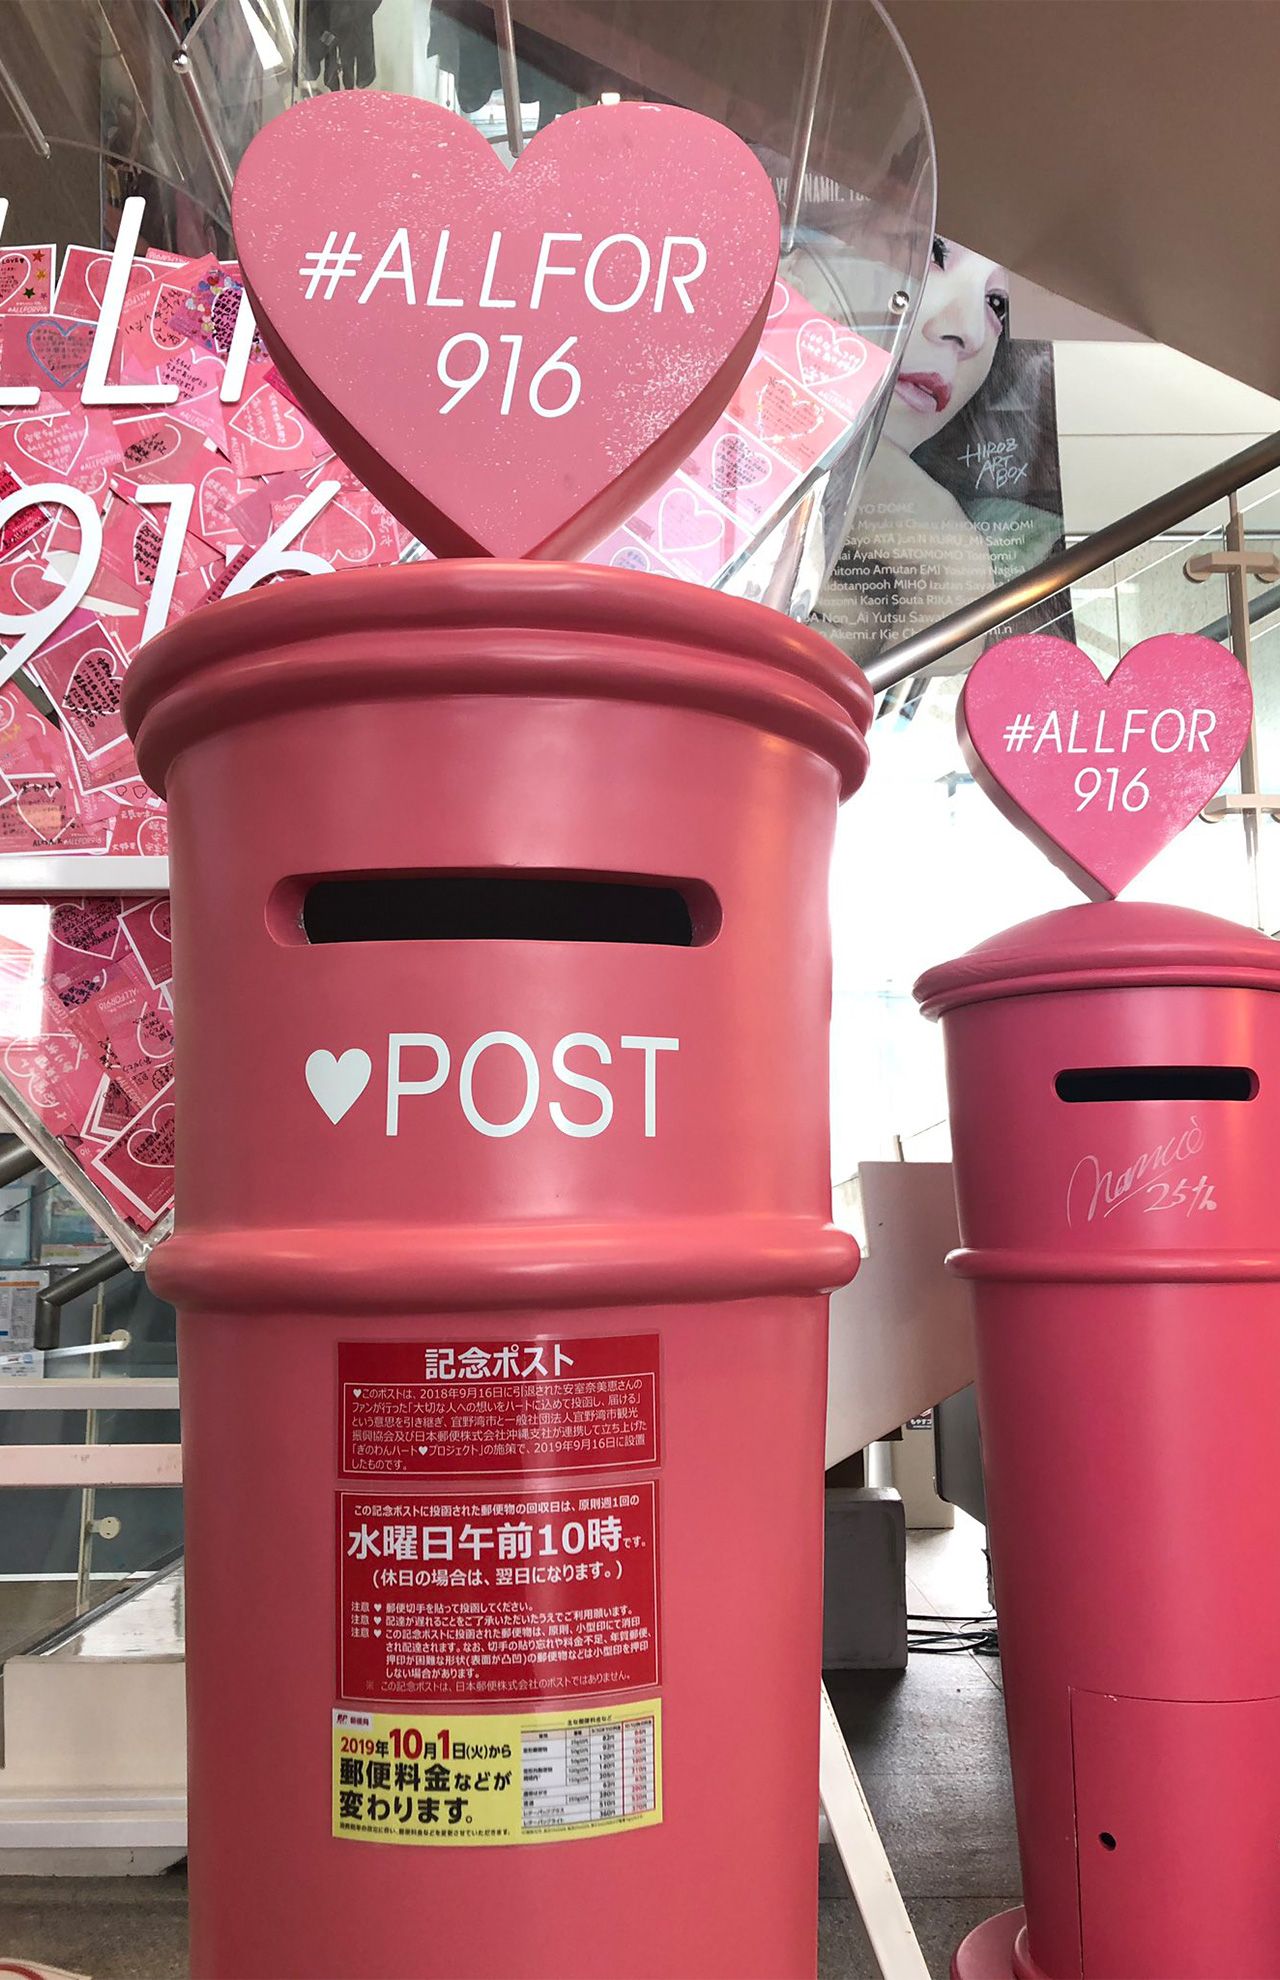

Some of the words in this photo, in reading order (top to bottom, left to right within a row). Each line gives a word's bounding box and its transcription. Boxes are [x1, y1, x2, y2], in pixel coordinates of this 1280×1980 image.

[300, 229, 706, 314] #ALLFOR
[438, 333, 581, 417] 916
[996, 463, 1029, 489] BOX
[993, 519, 1034, 532] NAOMI
[853, 549, 890, 563] AyaNo
[892, 549, 963, 560] SATOMOMO
[873, 564, 918, 576] Amutan
[920, 565, 941, 575] EMI
[893, 579, 927, 590] MIHO
[860, 594, 889, 606] Kaori
[891, 594, 924, 606] Souta
[872, 611, 906, 624] Yutsu
[879, 628, 899, 640] Kie
[1004, 709, 1216, 755] #ALLFOR
[1074, 768, 1149, 812] 916
[387, 1032, 679, 1138] POST
[424, 1343, 575, 1380] 記念ポスト
[351, 1459, 407, 1470] したものです。
[351, 1602, 370, 1613] 注意
[351, 1614, 370, 1626] 注意
[351, 1627, 370, 1638] 注意
[386, 1668, 480, 1679] しない場合があります。
[340, 1728, 512, 1760] 2019年10月1日(火)から
[339, 1757, 512, 1792] 郵便料金などが
[339, 1790, 473, 1824] 変わります。
